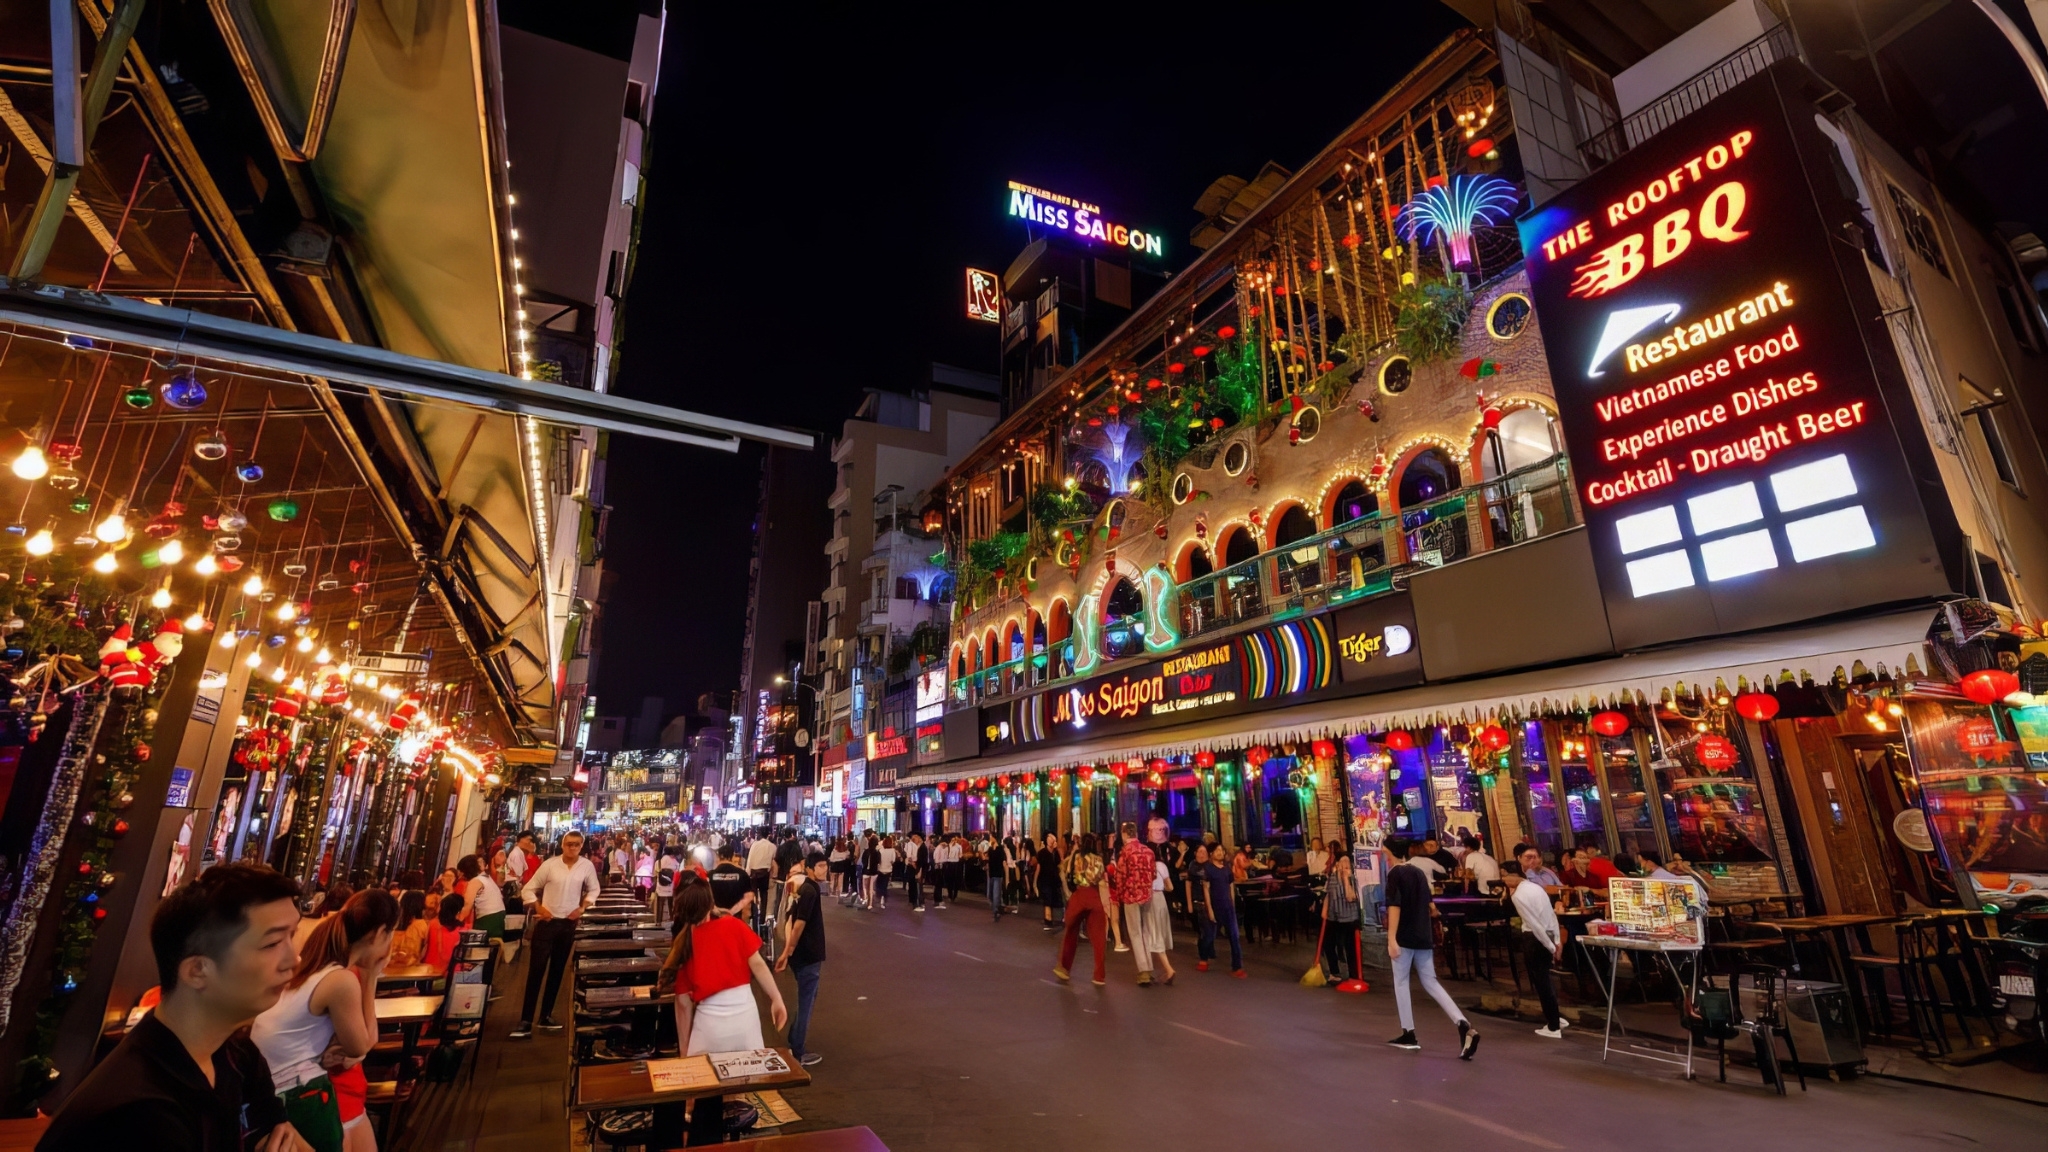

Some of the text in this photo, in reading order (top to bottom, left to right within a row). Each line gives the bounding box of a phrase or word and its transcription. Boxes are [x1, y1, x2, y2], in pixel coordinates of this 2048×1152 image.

[1074, 208, 1162, 257] SAIGON
[1542, 129, 1753, 261] THE ROOFTOP
[1574, 181, 1750, 297] BBQ
[1625, 281, 1794, 373] Restaurant
[1596, 325, 1801, 422] Vietnamese Food
[1602, 371, 1819, 461] Experience Dishes
[1587, 457, 1674, 505] Cocktail
[1690, 422, 1792, 474] Draught
[1797, 401, 1865, 441] Beer
[1338, 632, 1383, 663] Tiger
[1097, 675, 1164, 719] Saigon
